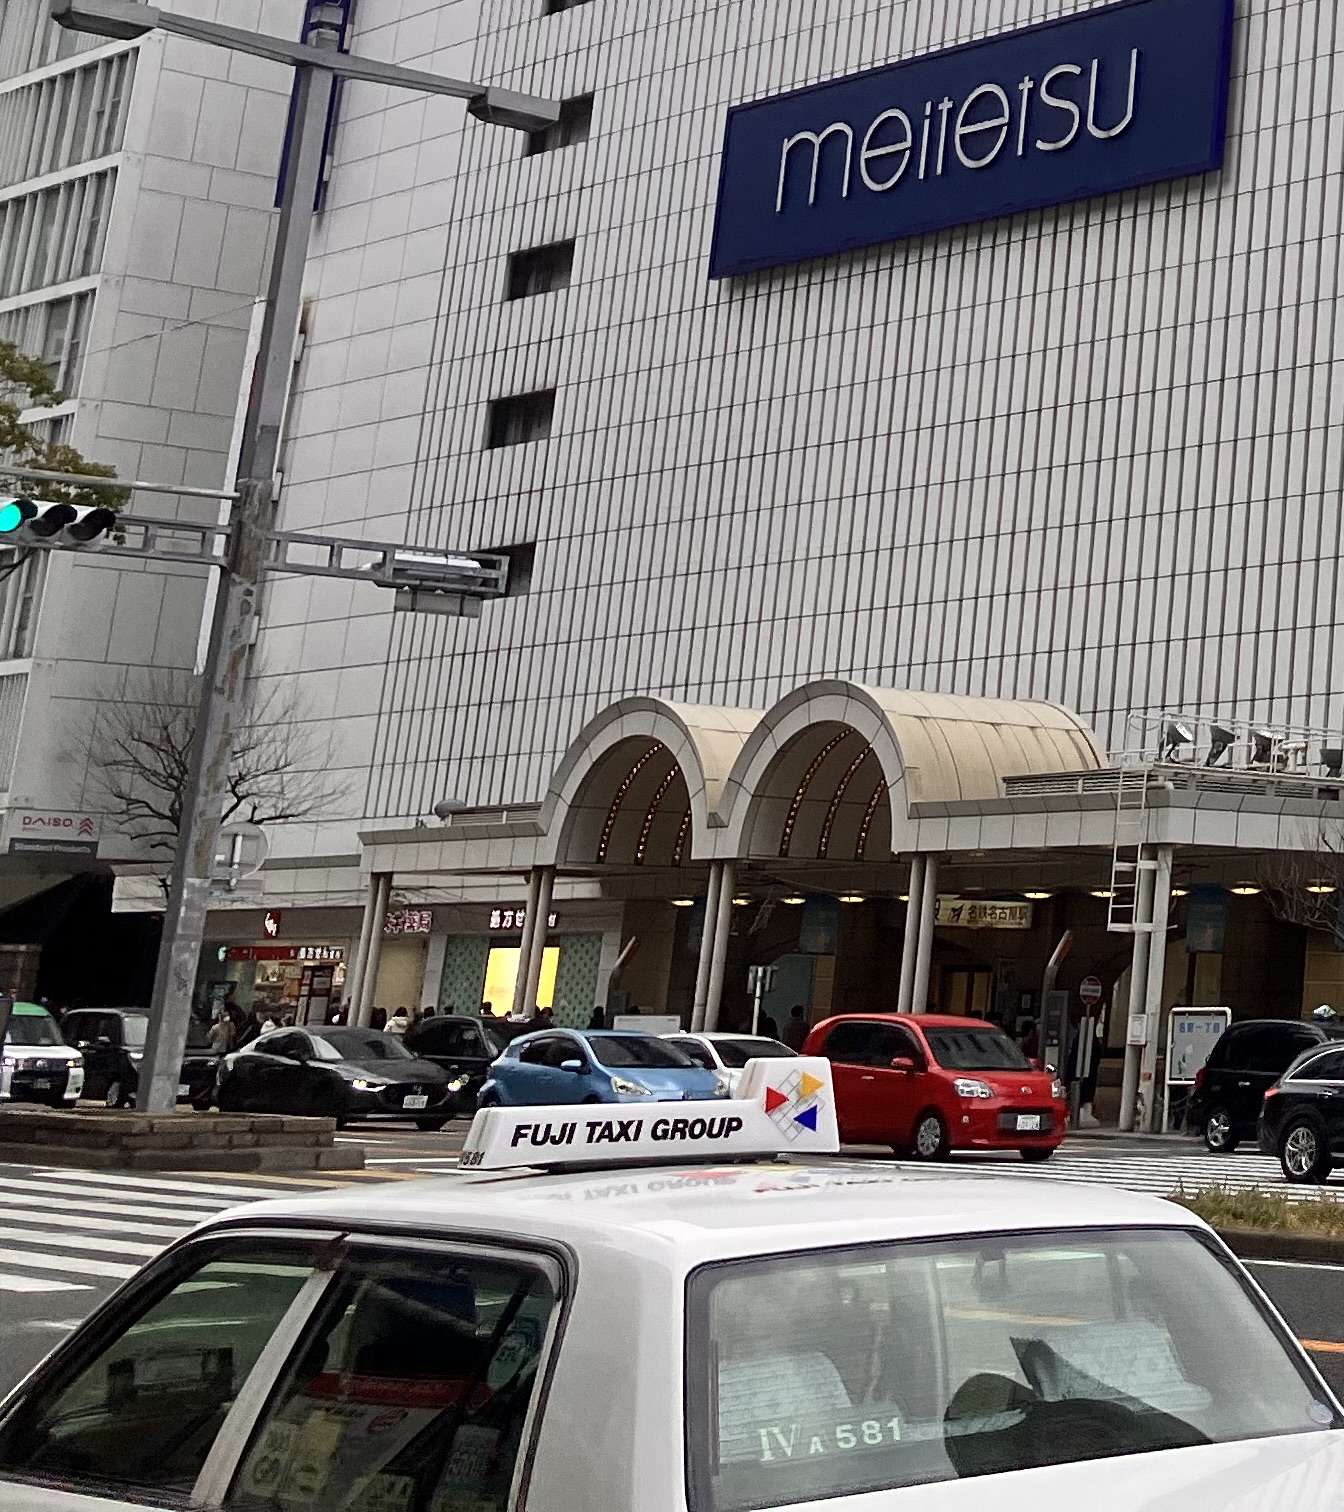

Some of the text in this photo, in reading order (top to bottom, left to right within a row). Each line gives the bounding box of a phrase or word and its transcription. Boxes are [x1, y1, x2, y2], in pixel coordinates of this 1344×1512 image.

[776, 47, 1139, 213] meitetsu
[22, 816, 73, 827] DAISO
[511, 1116, 743, 1148] FUJI TAXI GROUP
[807, 1437, 825, 1456] A
[835, 1417, 903, 1450] 581
